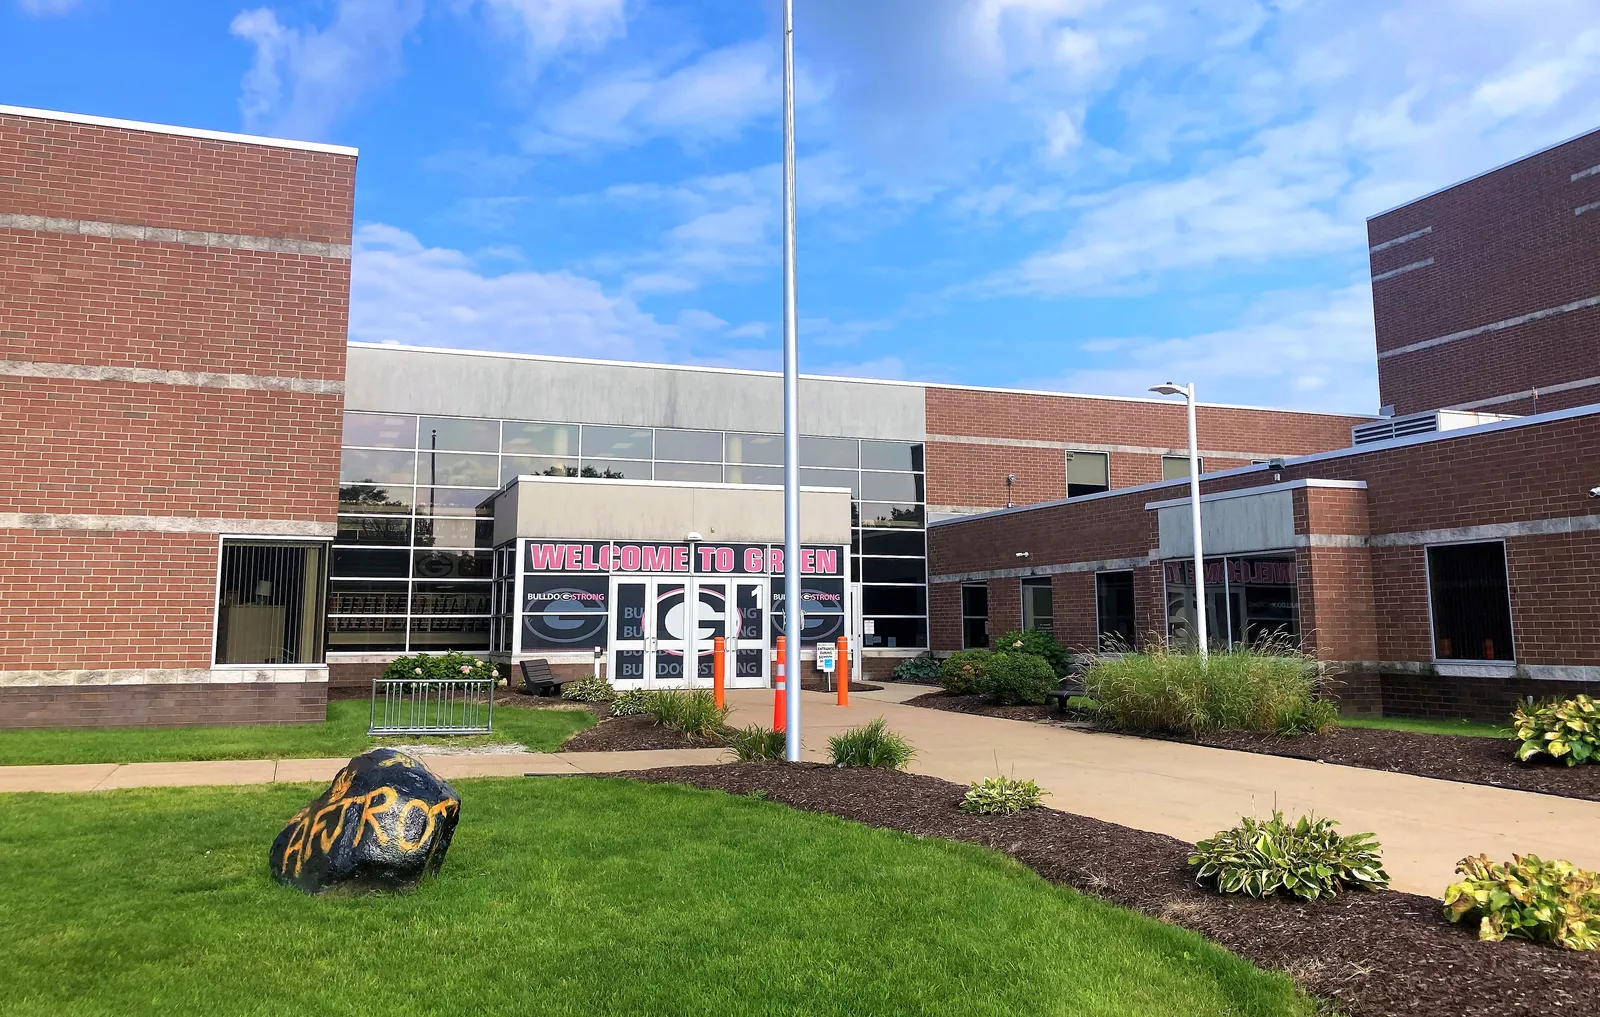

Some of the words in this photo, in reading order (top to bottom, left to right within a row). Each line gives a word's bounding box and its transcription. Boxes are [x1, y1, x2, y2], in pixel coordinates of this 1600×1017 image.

[531, 543, 689, 572] WELCOME
[698, 547, 735, 573] TO
[744, 548, 837, 574] GREN
[751, 585, 763, 609] 1
